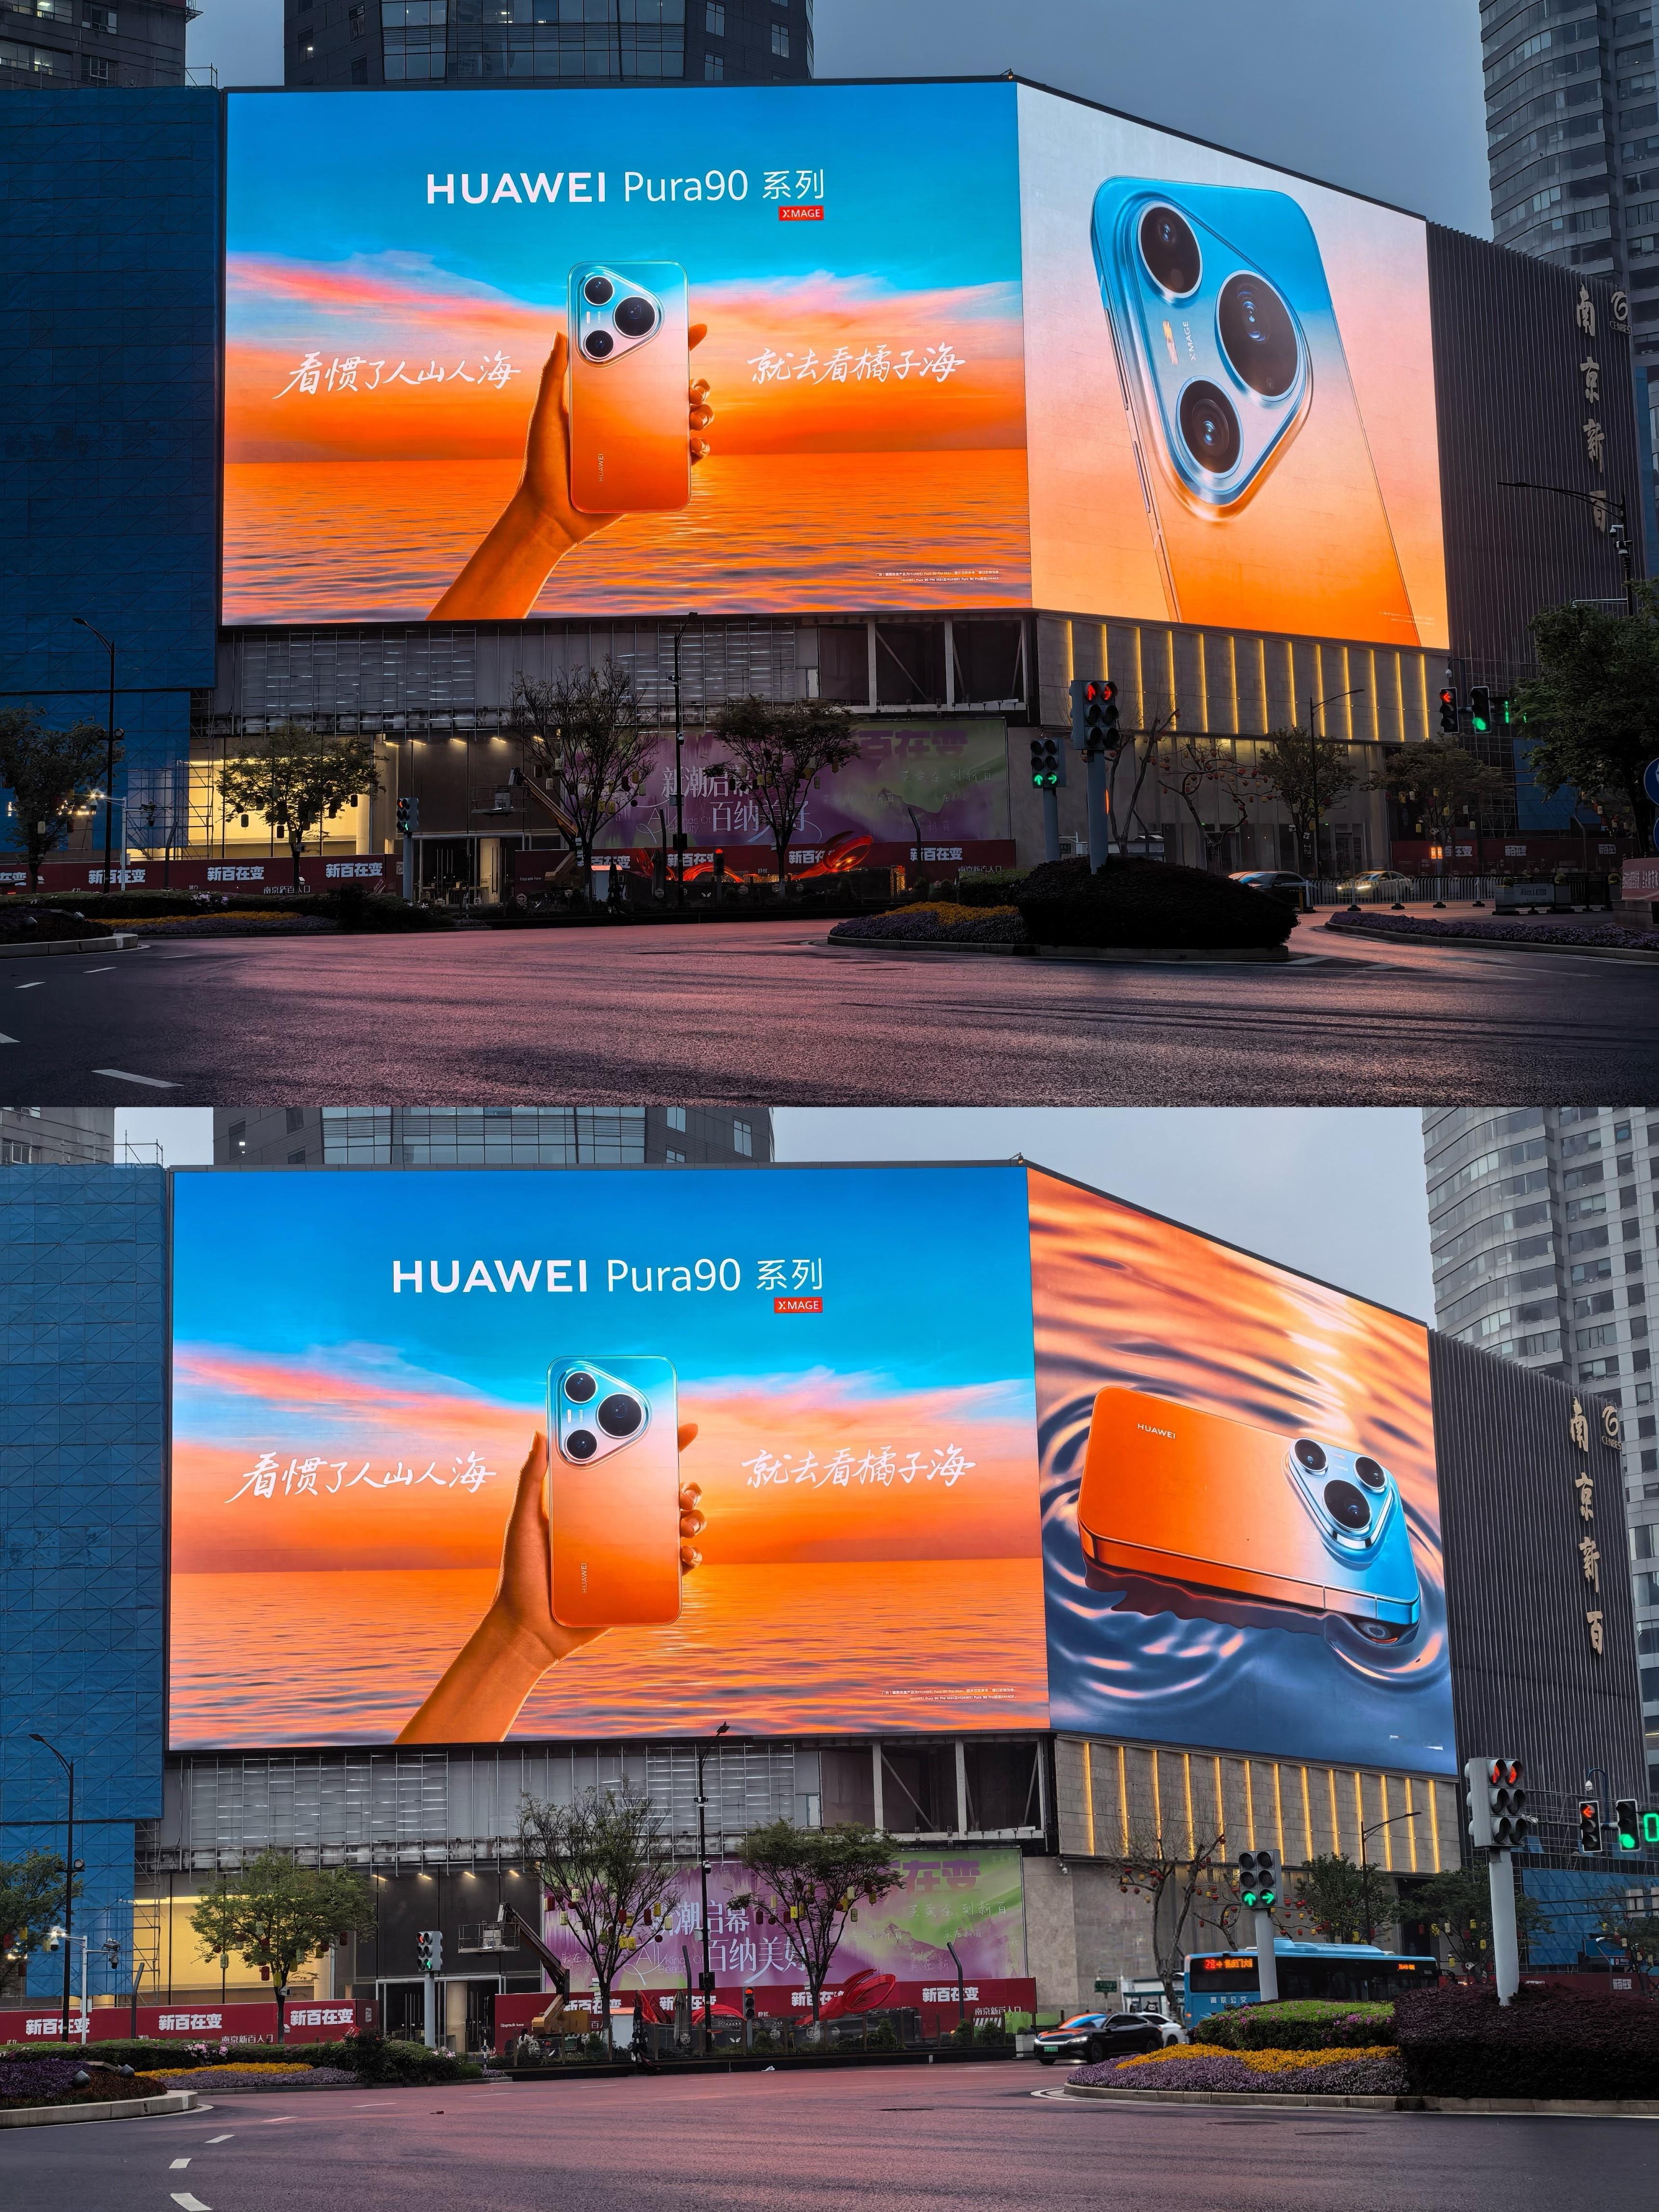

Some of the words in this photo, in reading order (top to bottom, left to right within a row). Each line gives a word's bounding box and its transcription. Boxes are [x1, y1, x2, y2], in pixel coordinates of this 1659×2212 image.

[427, 172, 605, 205] HUAWEI
[625, 169, 748, 201] Pura90
[762, 168, 825, 200] 系列
[782, 209, 821, 218] XMAGE
[1182, 320, 1197, 362] XMAGE
[272, 350, 522, 400] 看惯了人山人海
[748, 341, 966, 385] 就去看橘子海
[1577, 284, 1607, 532] 南京新百
[207, 866, 264, 881] 新百在变
[326, 862, 383, 878] 新百在变
[393, 1260, 588, 1293] HUAWEI
[607, 1258, 741, 1292] Pura90
[756, 1257, 823, 1291] 系列
[778, 1300, 819, 1310] XMAGE
[1137, 1422, 1177, 1439] HUAWEI
[224, 1450, 497, 1504] 看惯了人山人海
[741, 1442, 977, 1489] 就去看橘子海
[1570, 1397, 1605, 1655] 南京新百
[658, 1965, 687, 1974] Beaut
[666, 1956, 685, 1965] Kind
[708, 1936, 811, 1983] 百纳美好
[791, 1990, 845, 2007] 新百在
[159, 2013, 223, 2031] 新百在变
[291, 2008, 354, 2026] 新百在变
